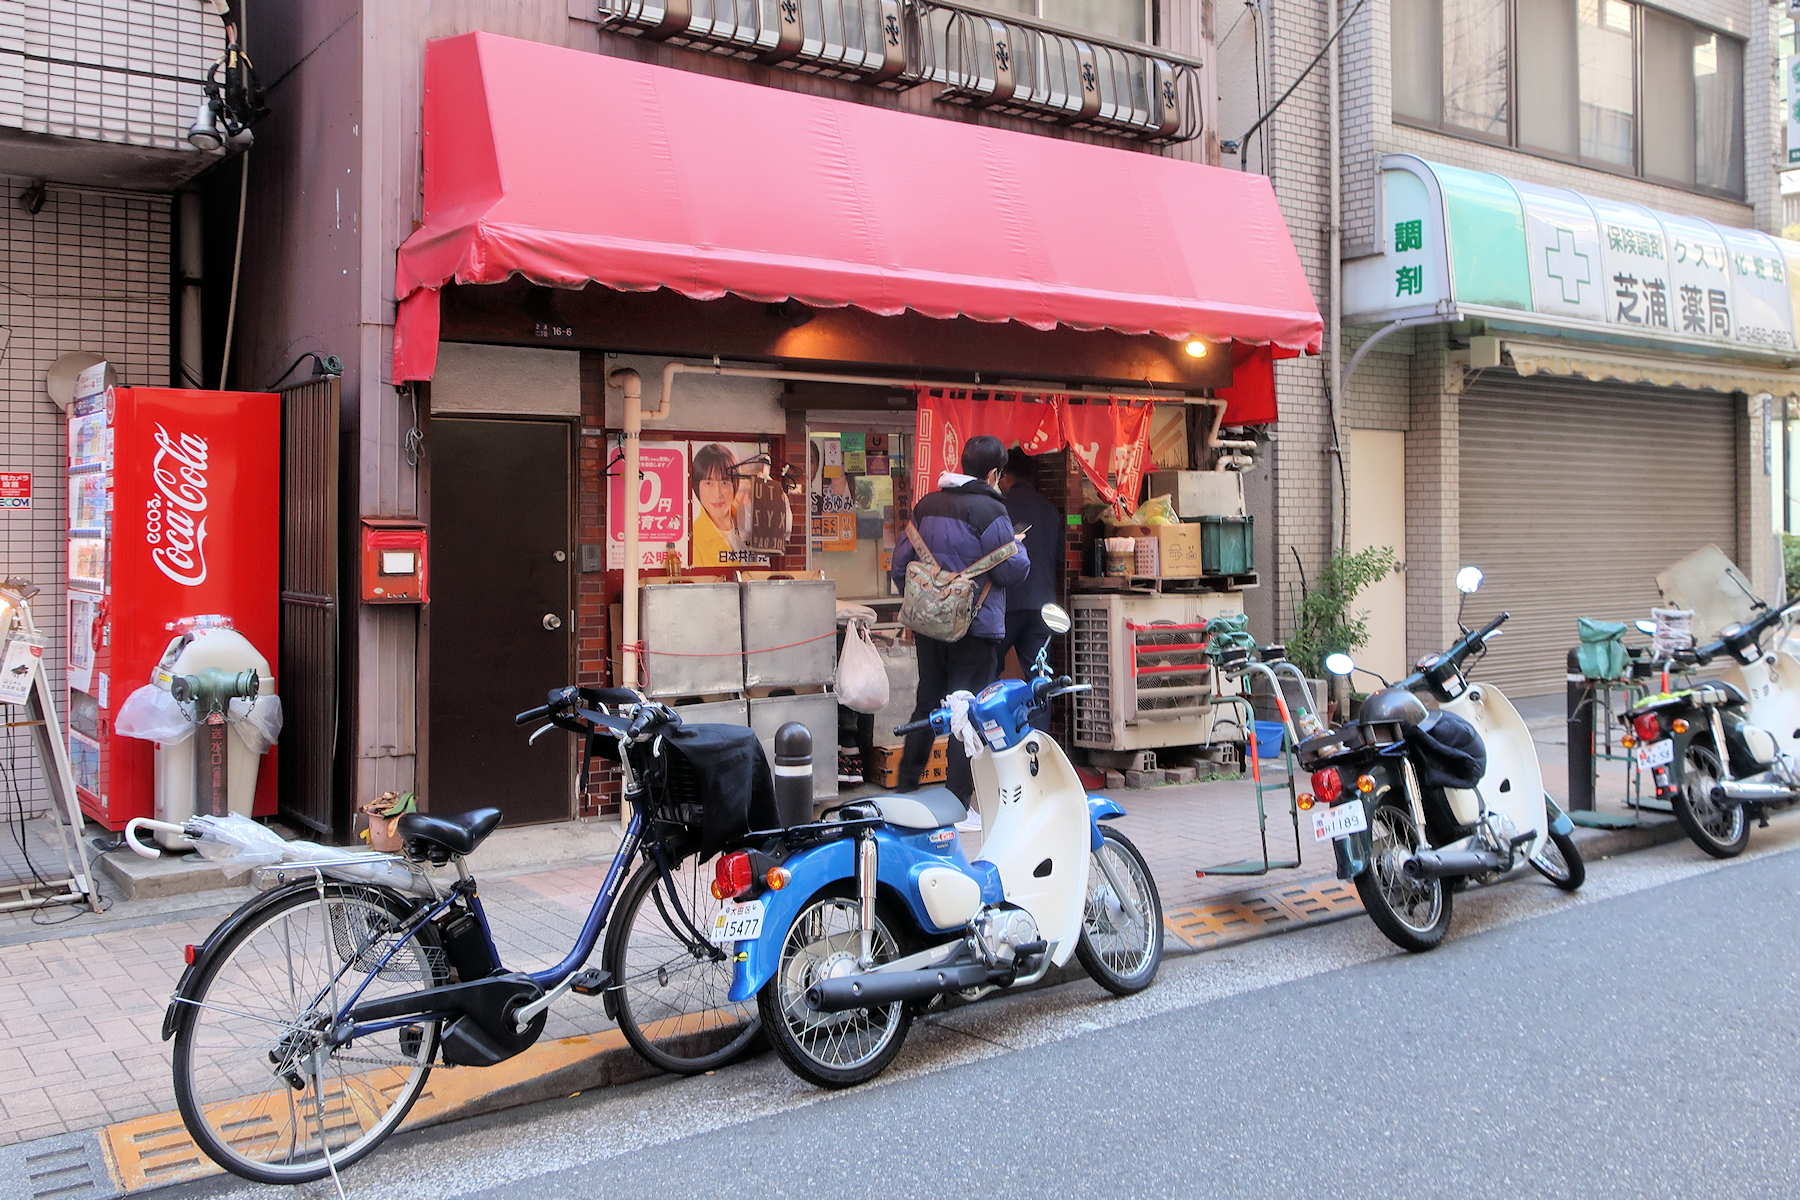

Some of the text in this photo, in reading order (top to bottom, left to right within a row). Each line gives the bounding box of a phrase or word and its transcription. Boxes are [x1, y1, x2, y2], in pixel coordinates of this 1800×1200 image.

[1395, 220, 1422, 297] 調剤
[1607, 225, 1784, 283] 保険調剤 クスリ 化粧品
[1613, 272, 1731, 337] 芝浦薬局
[552, 326, 573, 337] 16-6
[152, 422, 208, 586] Coca-Cola
[823, 495, 854, 511] あゆみ
[638, 515, 667, 530] 育て
[642, 551, 682, 565] 公明
[210, 728, 222, 765] 送水口
[1332, 815, 1359, 832] 1189
[607, 865, 624, 896] Panasonic
[730, 905, 751, 916] 大田区
[724, 918, 759, 937] 15477
